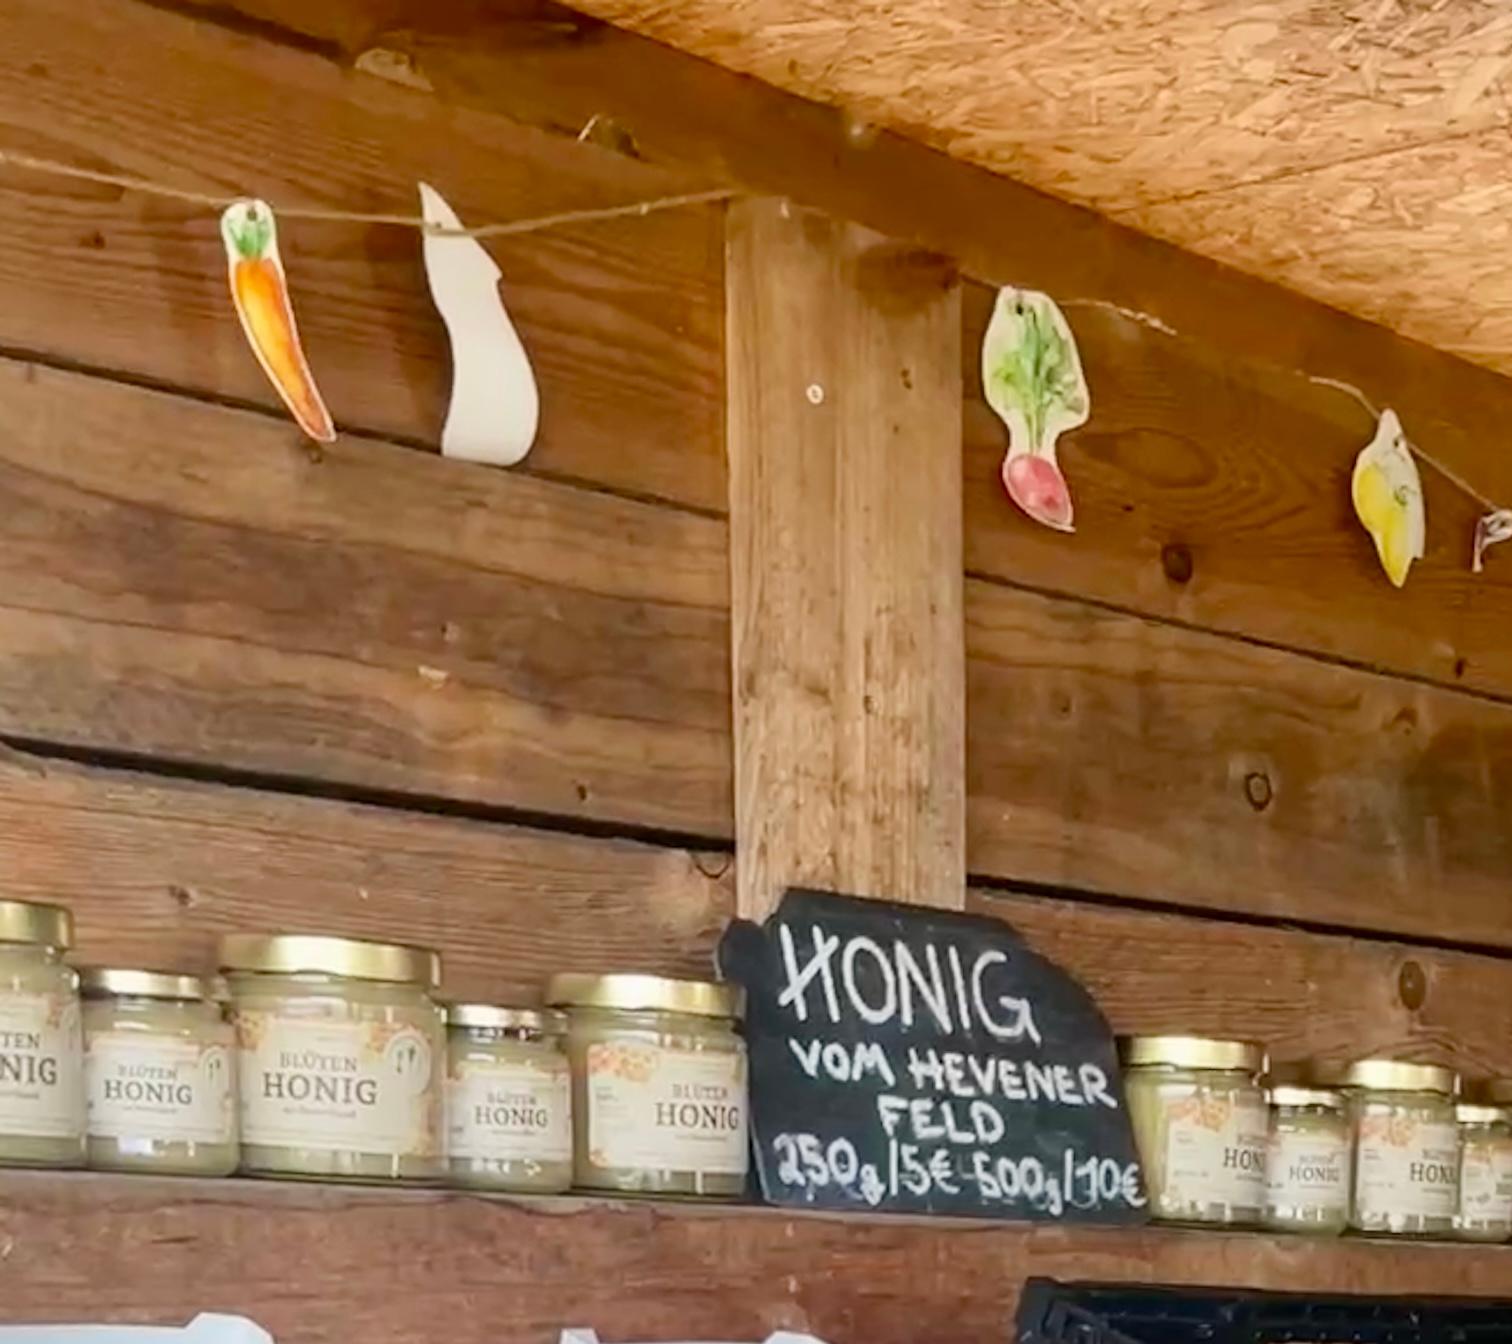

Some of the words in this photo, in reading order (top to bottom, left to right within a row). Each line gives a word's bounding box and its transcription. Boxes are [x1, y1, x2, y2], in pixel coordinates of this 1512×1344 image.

[778, 923, 1041, 1045] HONIG
[280, 1049, 358, 1073] BLÜTEN
[790, 1038, 895, 1086] VOM
[908, 1048, 1117, 1108] HEVENER
[104, 1079, 192, 1106] HONIG
[262, 1071, 377, 1106] HONIG
[474, 1106, 549, 1129] HONIG
[655, 1101, 740, 1131] HONIG
[878, 1095, 1004, 1144] FELD
